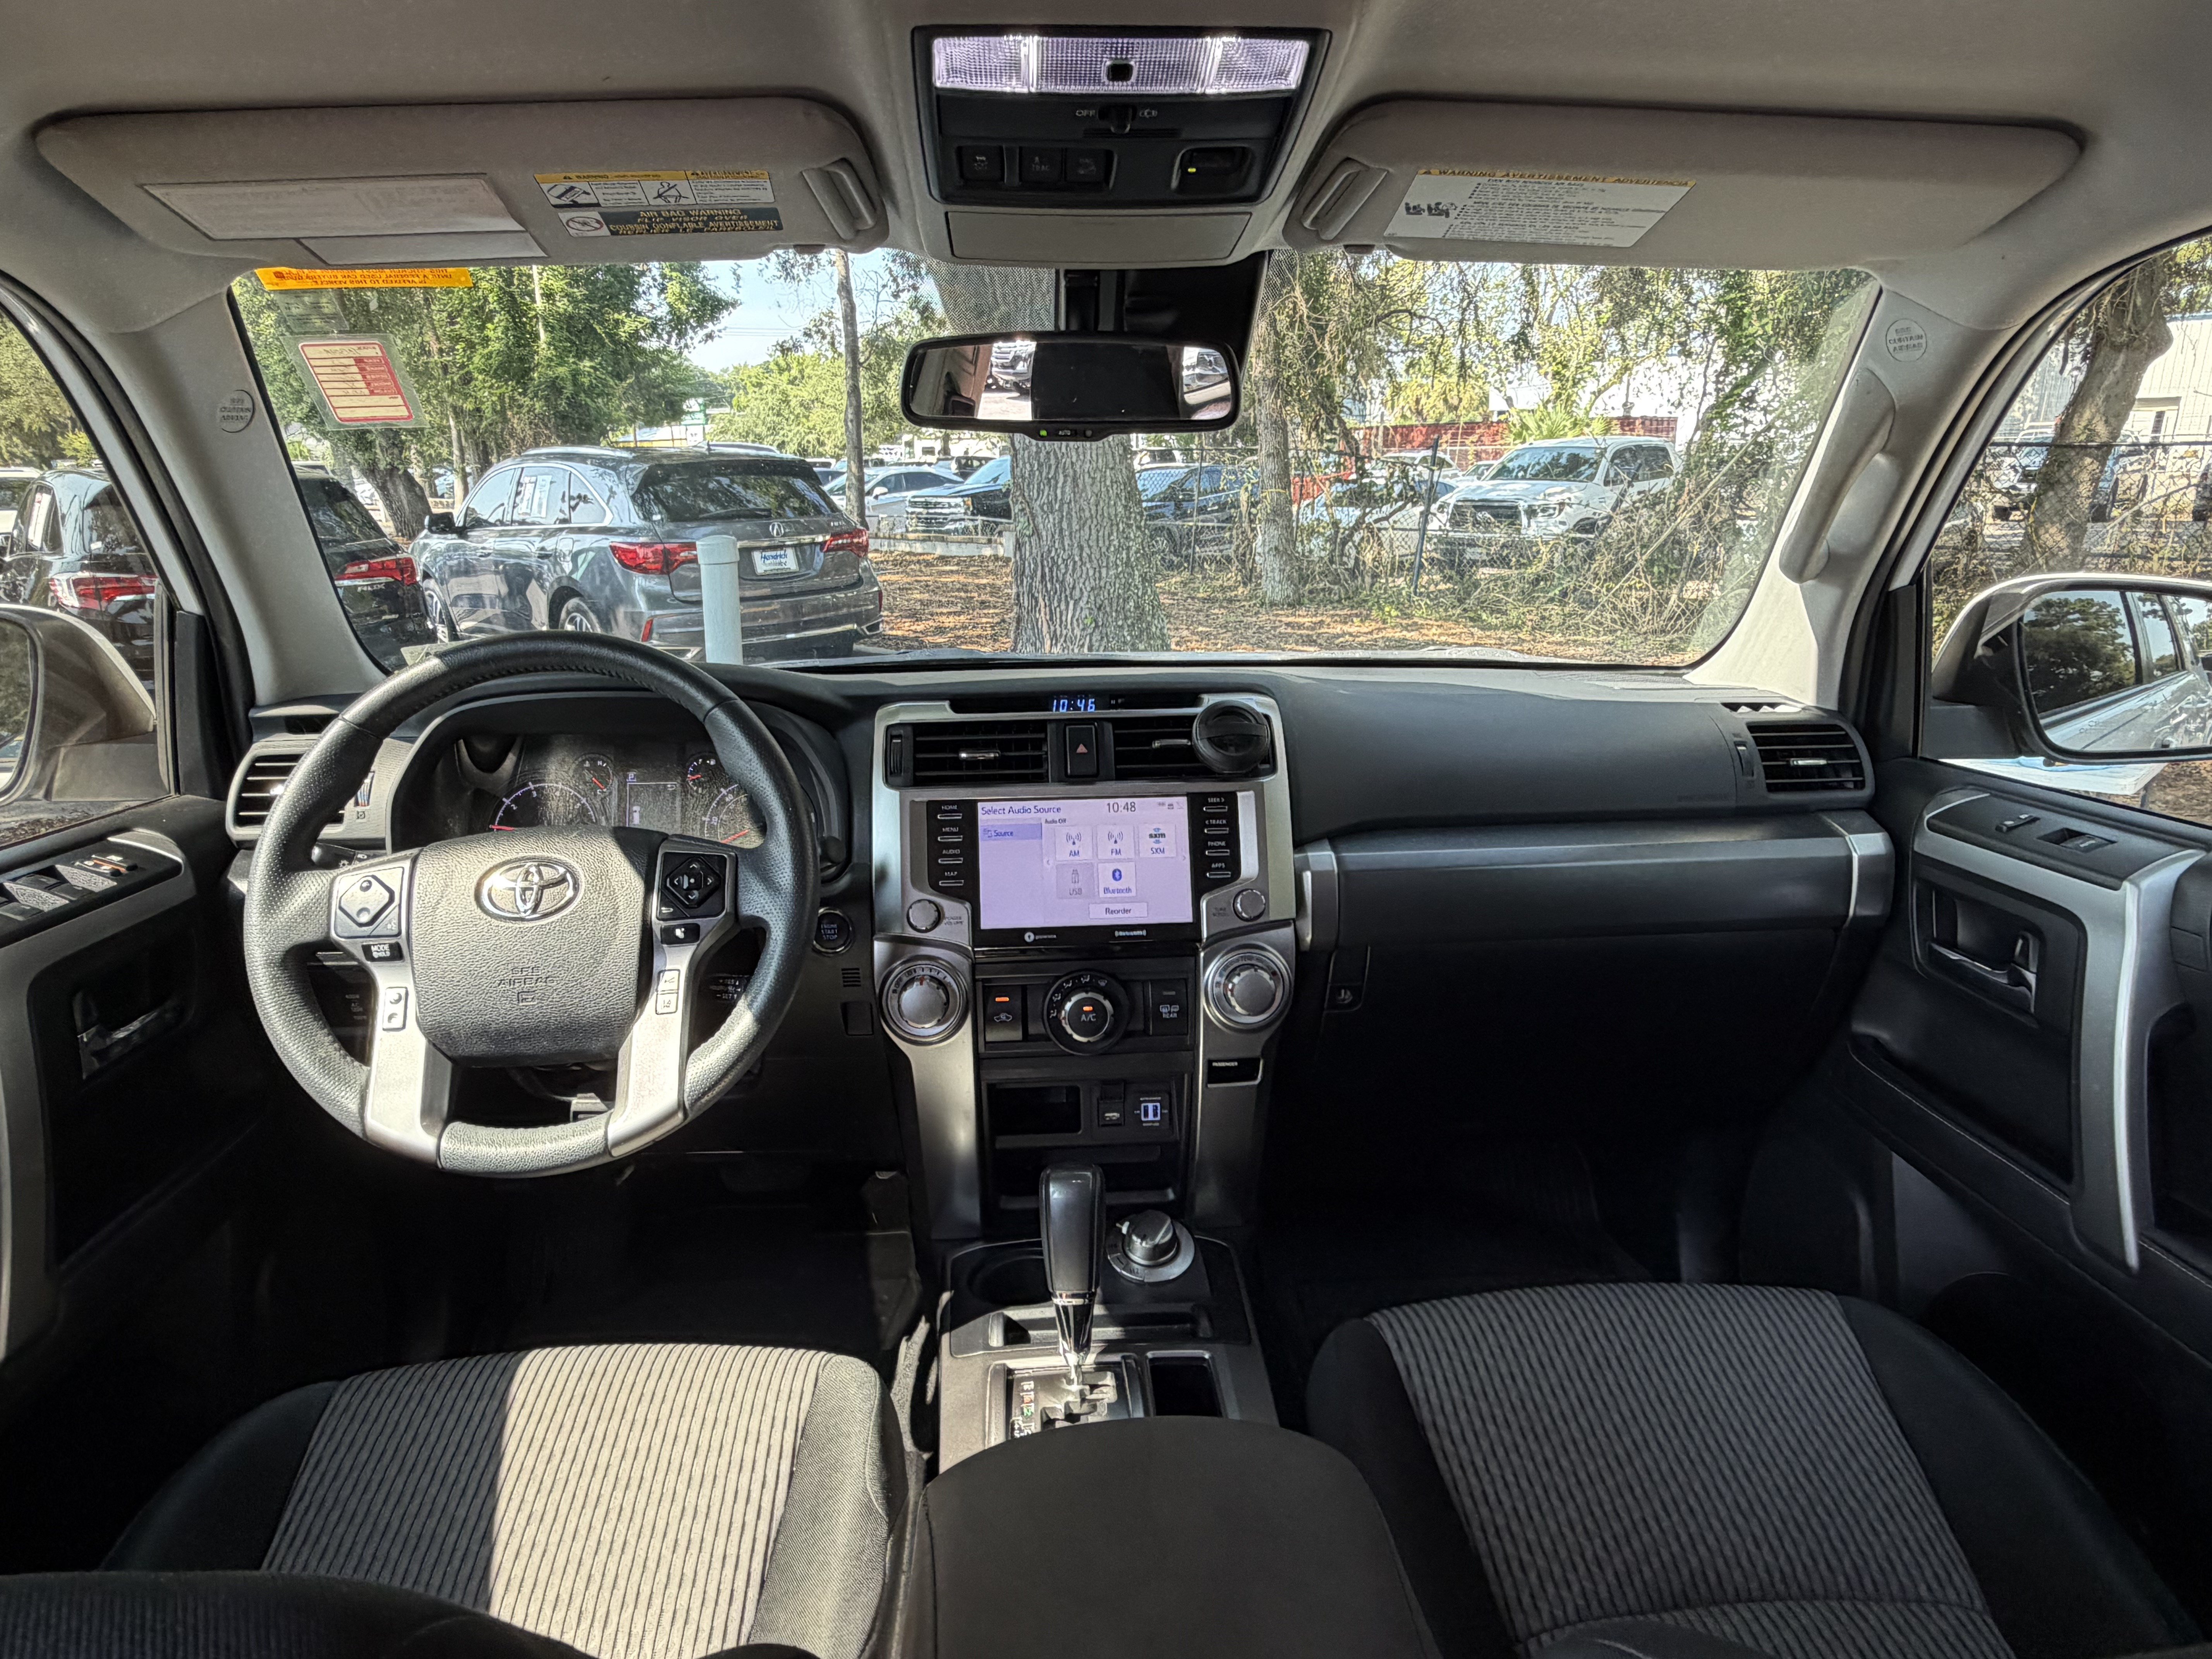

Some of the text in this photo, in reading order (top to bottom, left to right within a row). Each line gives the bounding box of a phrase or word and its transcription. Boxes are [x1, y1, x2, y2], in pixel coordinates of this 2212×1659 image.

[1053, 698, 1096, 713] 10:46
[981, 805, 1061, 815] Select Audio Source
[1106, 802, 1136, 813] 10:48
[1069, 888, 1082, 896] USB
[1103, 886, 1132, 895] Bluetooth
[498, 976, 558, 988] AIRBAG
